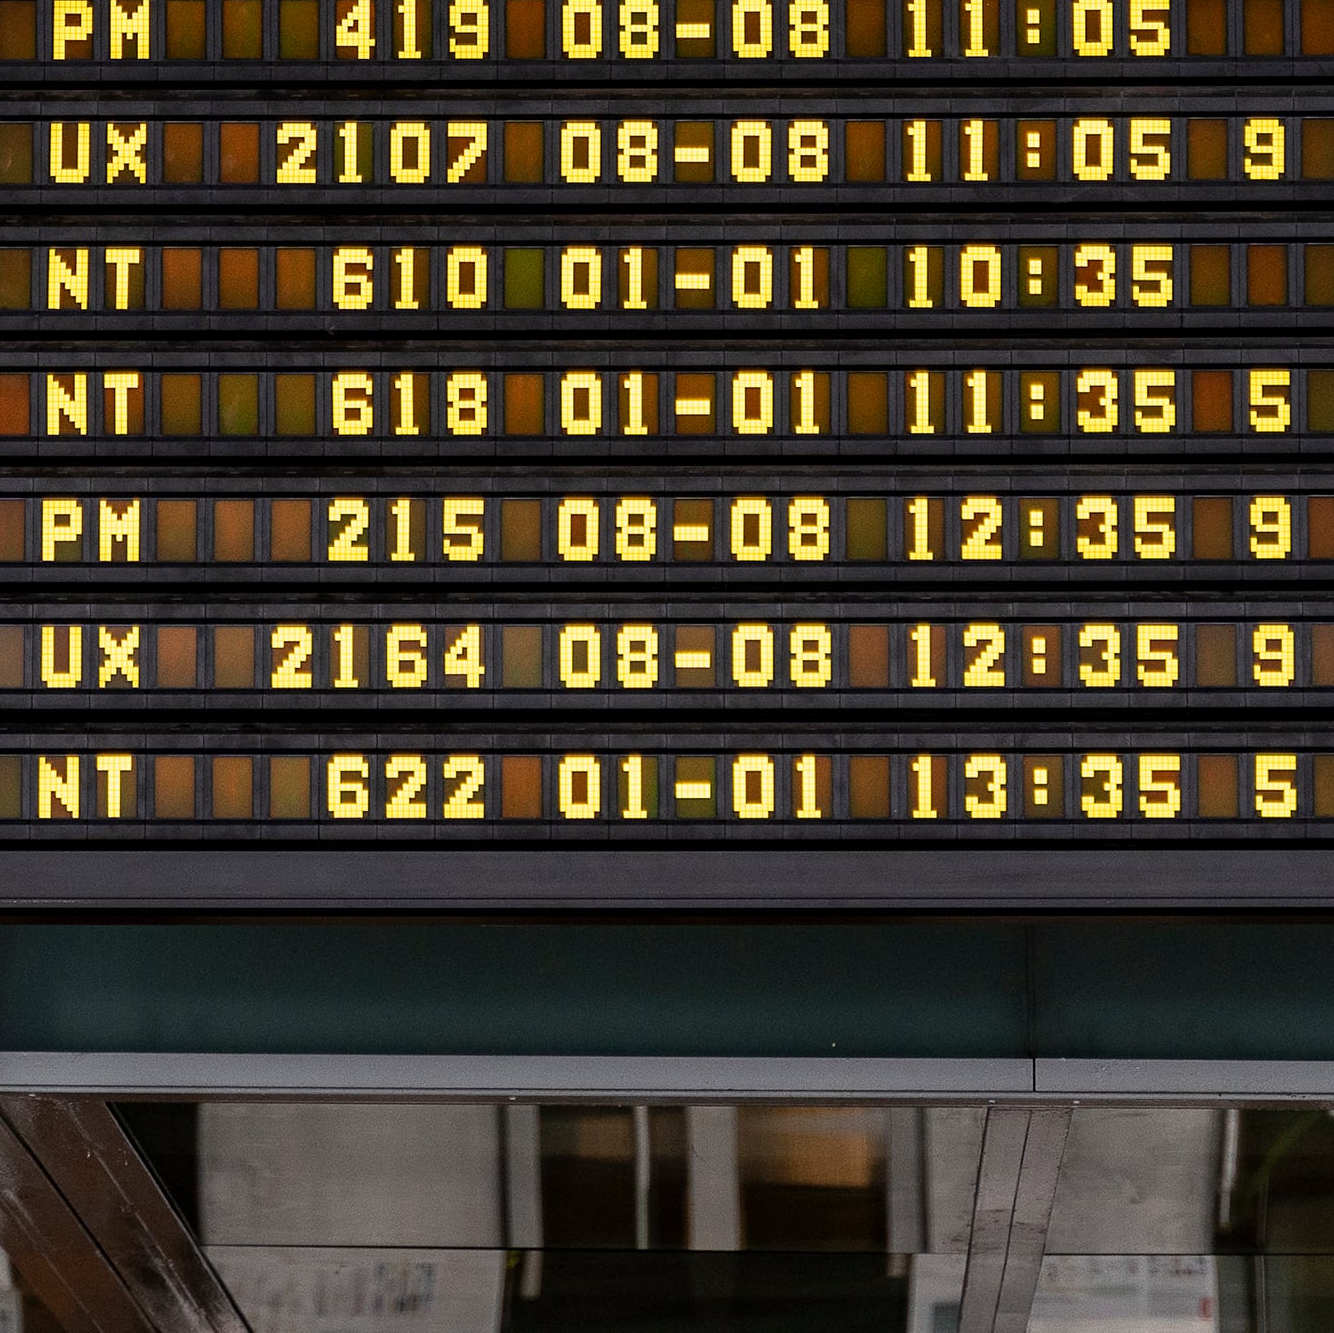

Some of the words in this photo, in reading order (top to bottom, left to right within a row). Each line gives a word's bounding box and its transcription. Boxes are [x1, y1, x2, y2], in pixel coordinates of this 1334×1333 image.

[49, 122, 147, 184] UX
[276, 122, 488, 184] 2107
[560, 121, 829, 183] 08-08
[907, 119, 1171, 182] 11:05
[1244, 119, 1285, 180] 9
[47, 248, 141, 310] NT
[332, 246, 488, 310] 610
[561, 246, 819, 310] 01-01
[908, 244, 1173, 308] 10:35
[46, 372, 139, 436] NT
[332, 373, 488, 436] 618
[560, 371, 820, 435] 01-01
[909, 370, 1176, 434] 11:35
[1249, 370, 1291, 432] 5
[42, 499, 140, 562] PM
[328, 499, 485, 562] 215
[558, 496, 830, 562] 08-08
[908, 495, 1176, 561] 12:35
[1249, 497, 1291, 559] 9
[41, 626, 140, 689] UX
[271, 624, 485, 689] 2164
[559, 623, 832, 689] 08-08
[910, 623, 1179, 688] 12:35
[1253, 624, 1295, 687] 9
[38, 754, 133, 819] NT
[327, 754, 485, 819] 622
[558, 754, 822, 819] 01-01
[911, 755, 1181, 819] 13:35
[1255, 754, 1297, 818] 5
